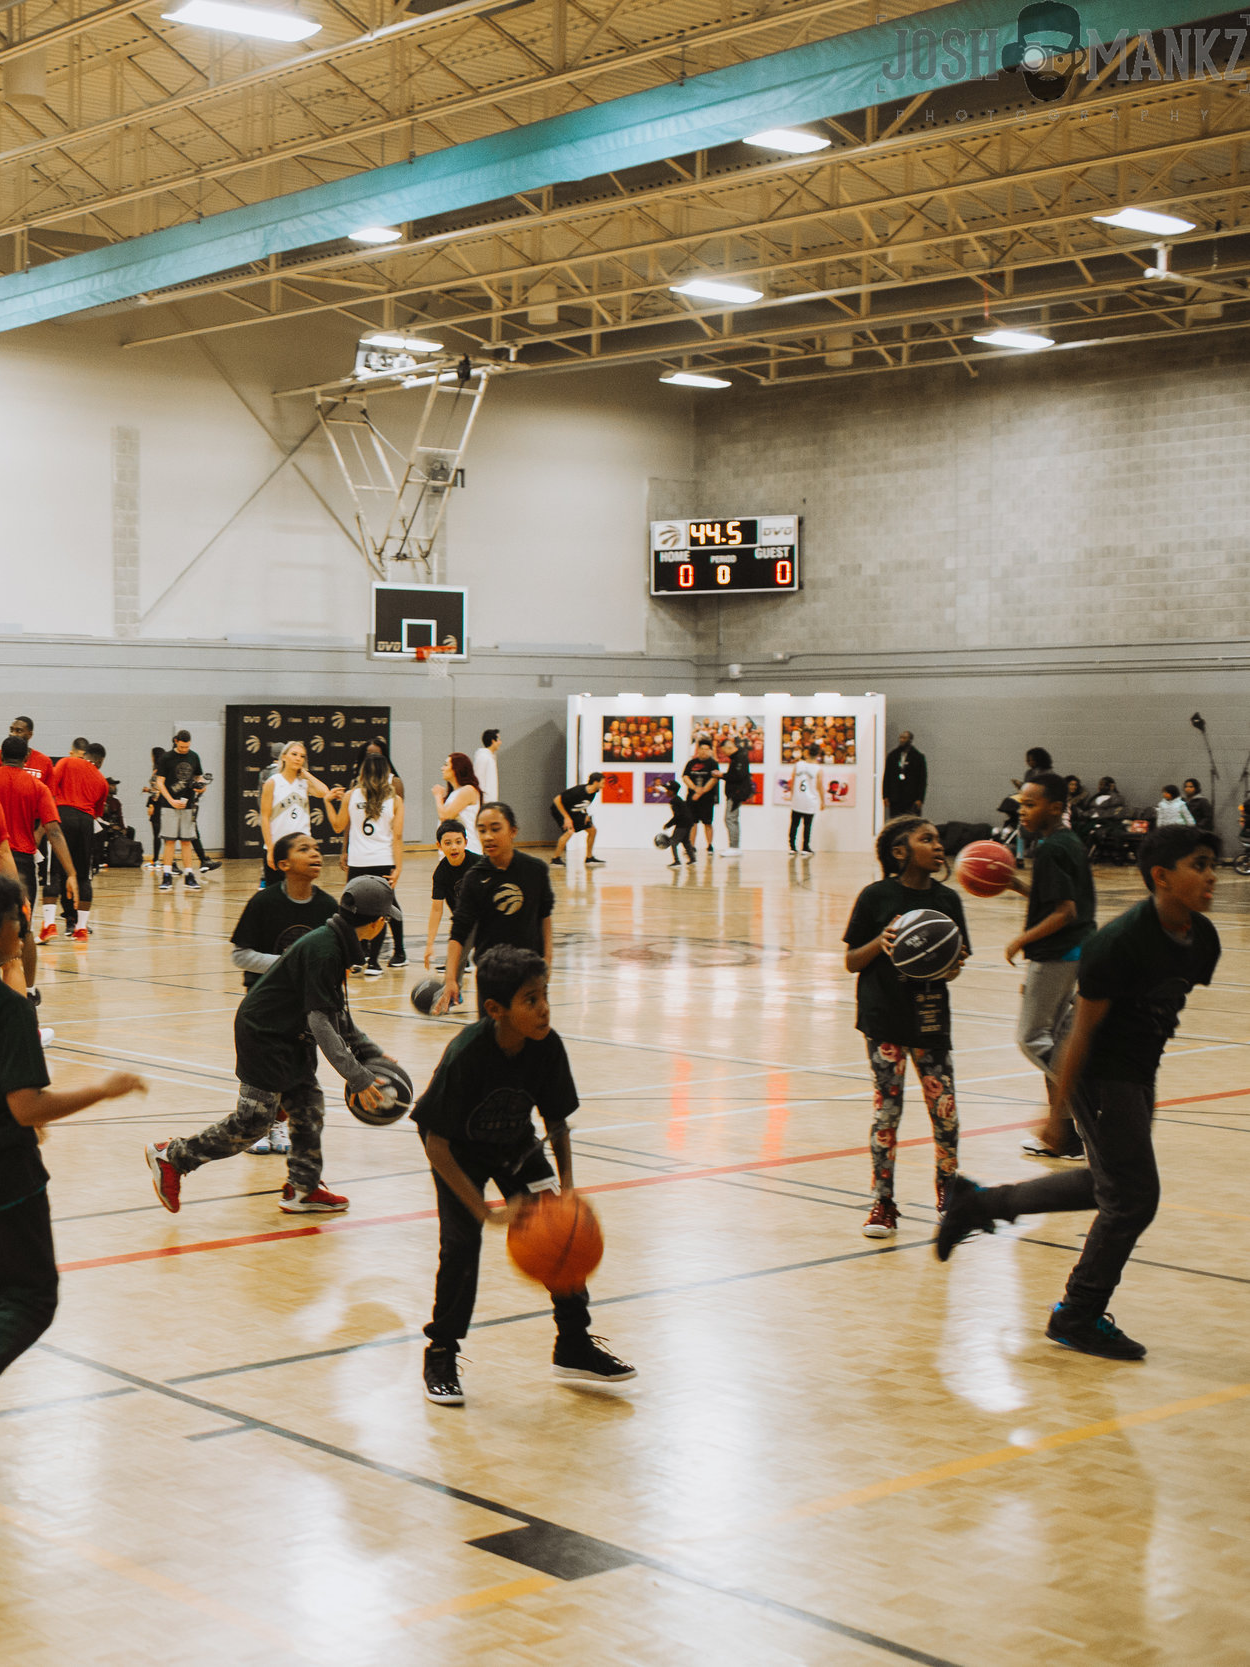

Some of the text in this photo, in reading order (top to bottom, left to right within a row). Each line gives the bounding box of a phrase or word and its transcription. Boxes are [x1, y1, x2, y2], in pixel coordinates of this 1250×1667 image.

[690, 520, 743, 545] 44.5
[659, 550, 691, 562] HOME
[754, 547, 790, 559] GUEST
[679, 564, 694, 588] 0
[716, 564, 731, 585] 0
[775, 560, 792, 585] 0
[376, 640, 402, 652] OVO
[800, 779, 807, 792] 6
[291, 807, 298, 820] 6
[363, 816, 375, 836] 6
